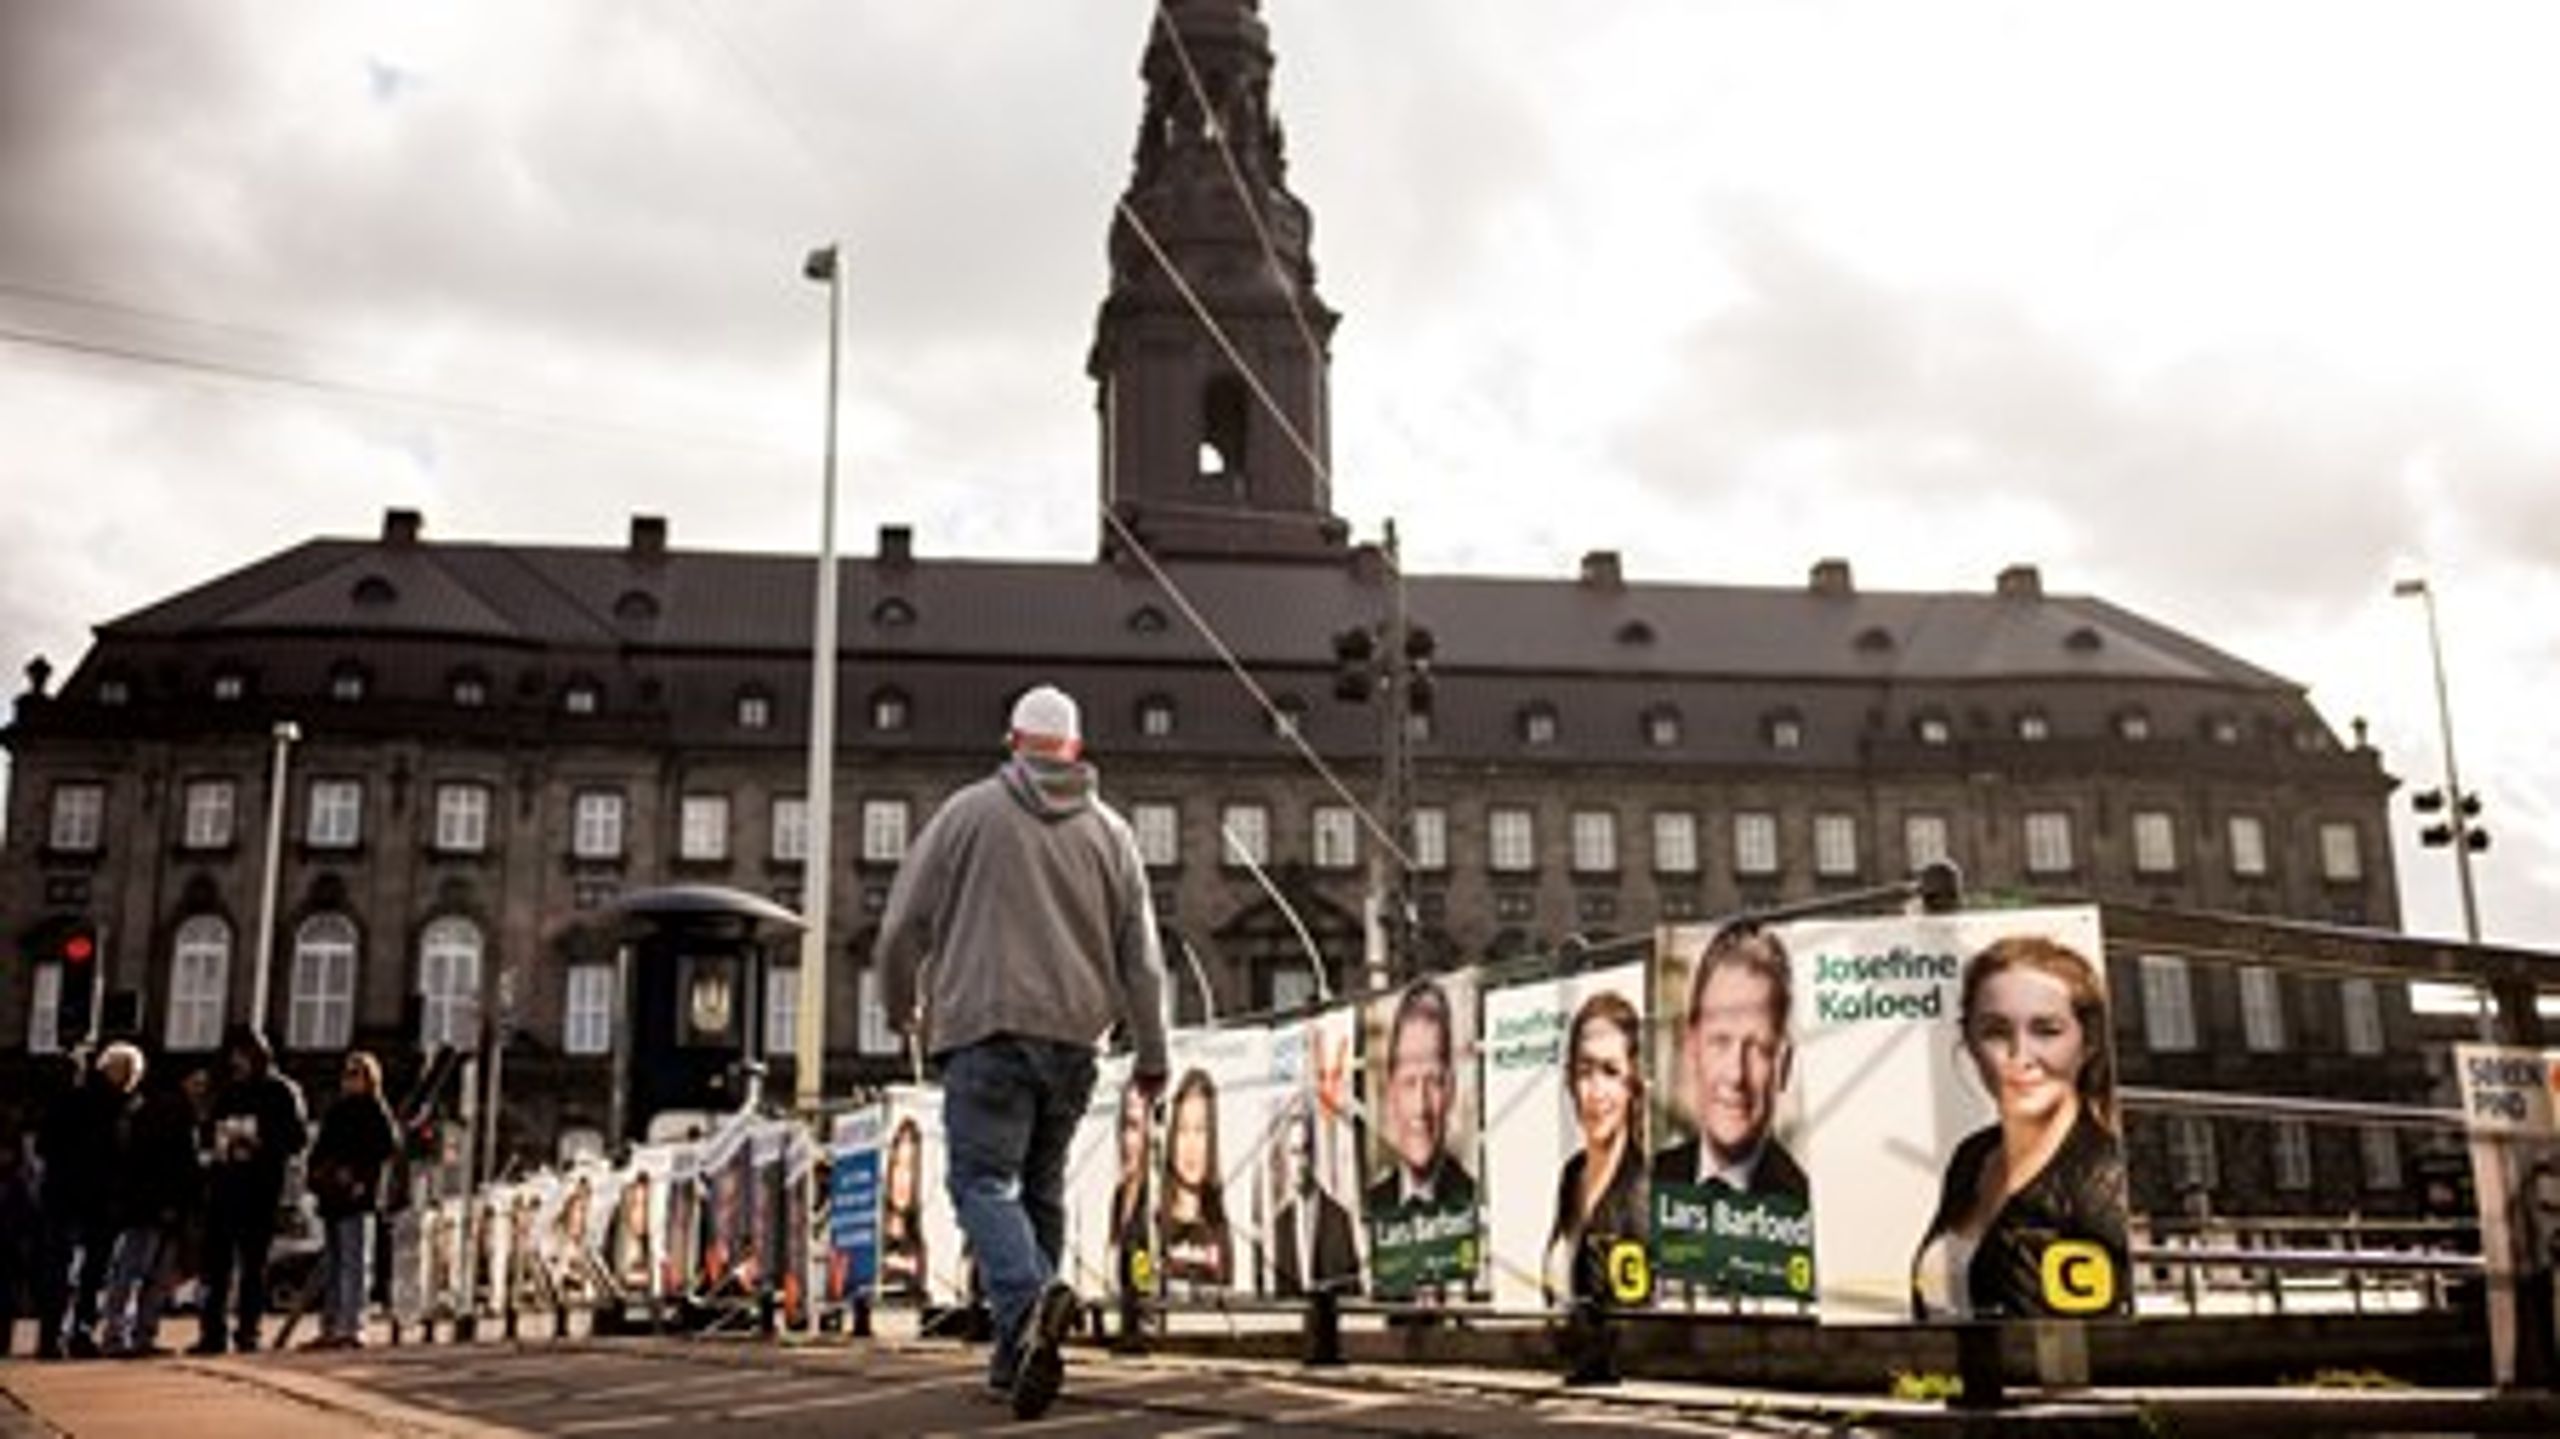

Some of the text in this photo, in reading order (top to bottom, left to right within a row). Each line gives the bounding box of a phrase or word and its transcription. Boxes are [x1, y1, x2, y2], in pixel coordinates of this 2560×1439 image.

[1815, 949, 1957, 983] Josefine
[1817, 984, 1941, 1021] Koloed
[1660, 1194, 1812, 1246] Lars Barfoed
[2059, 1255, 2095, 1297] C
